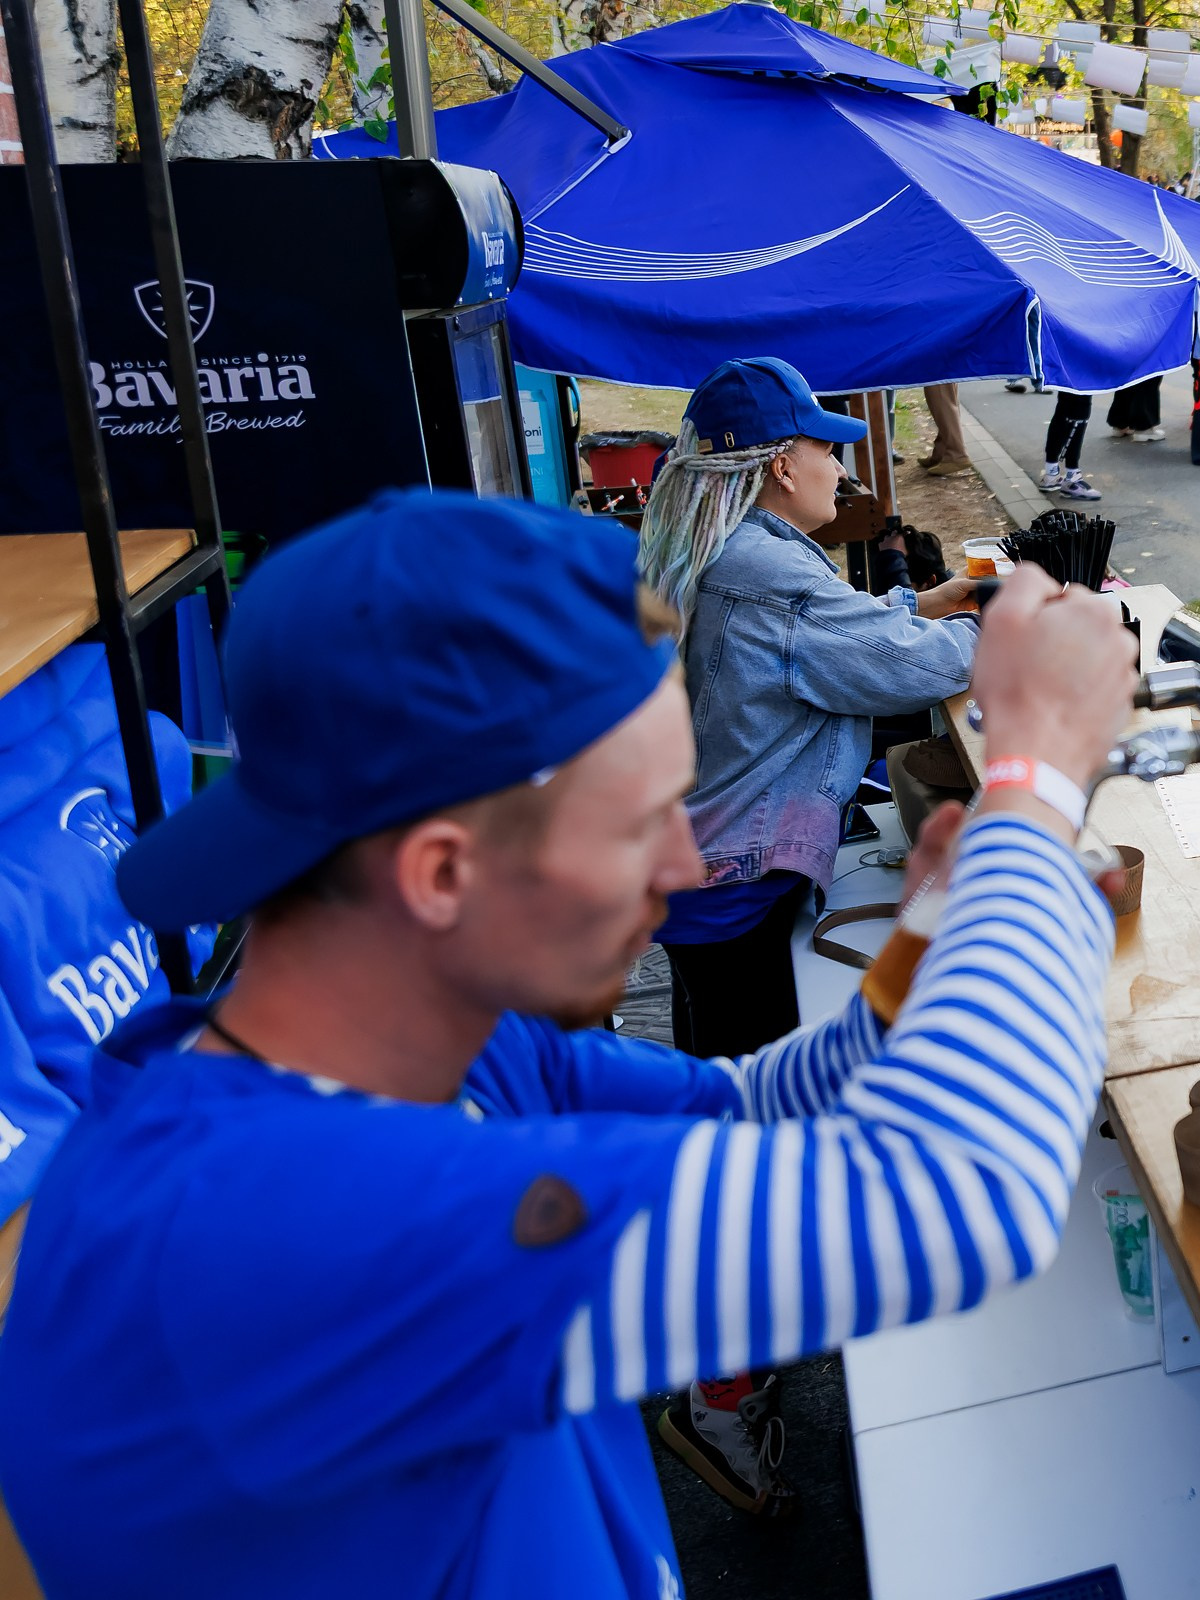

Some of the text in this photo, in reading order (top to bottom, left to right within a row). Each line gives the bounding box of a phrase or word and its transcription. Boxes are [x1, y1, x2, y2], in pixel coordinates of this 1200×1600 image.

[111, 354, 307, 369] HOLLA SINCE 1719
[97, 410, 306, 444] Famil Brewed
[524, 426, 542, 438] oni
